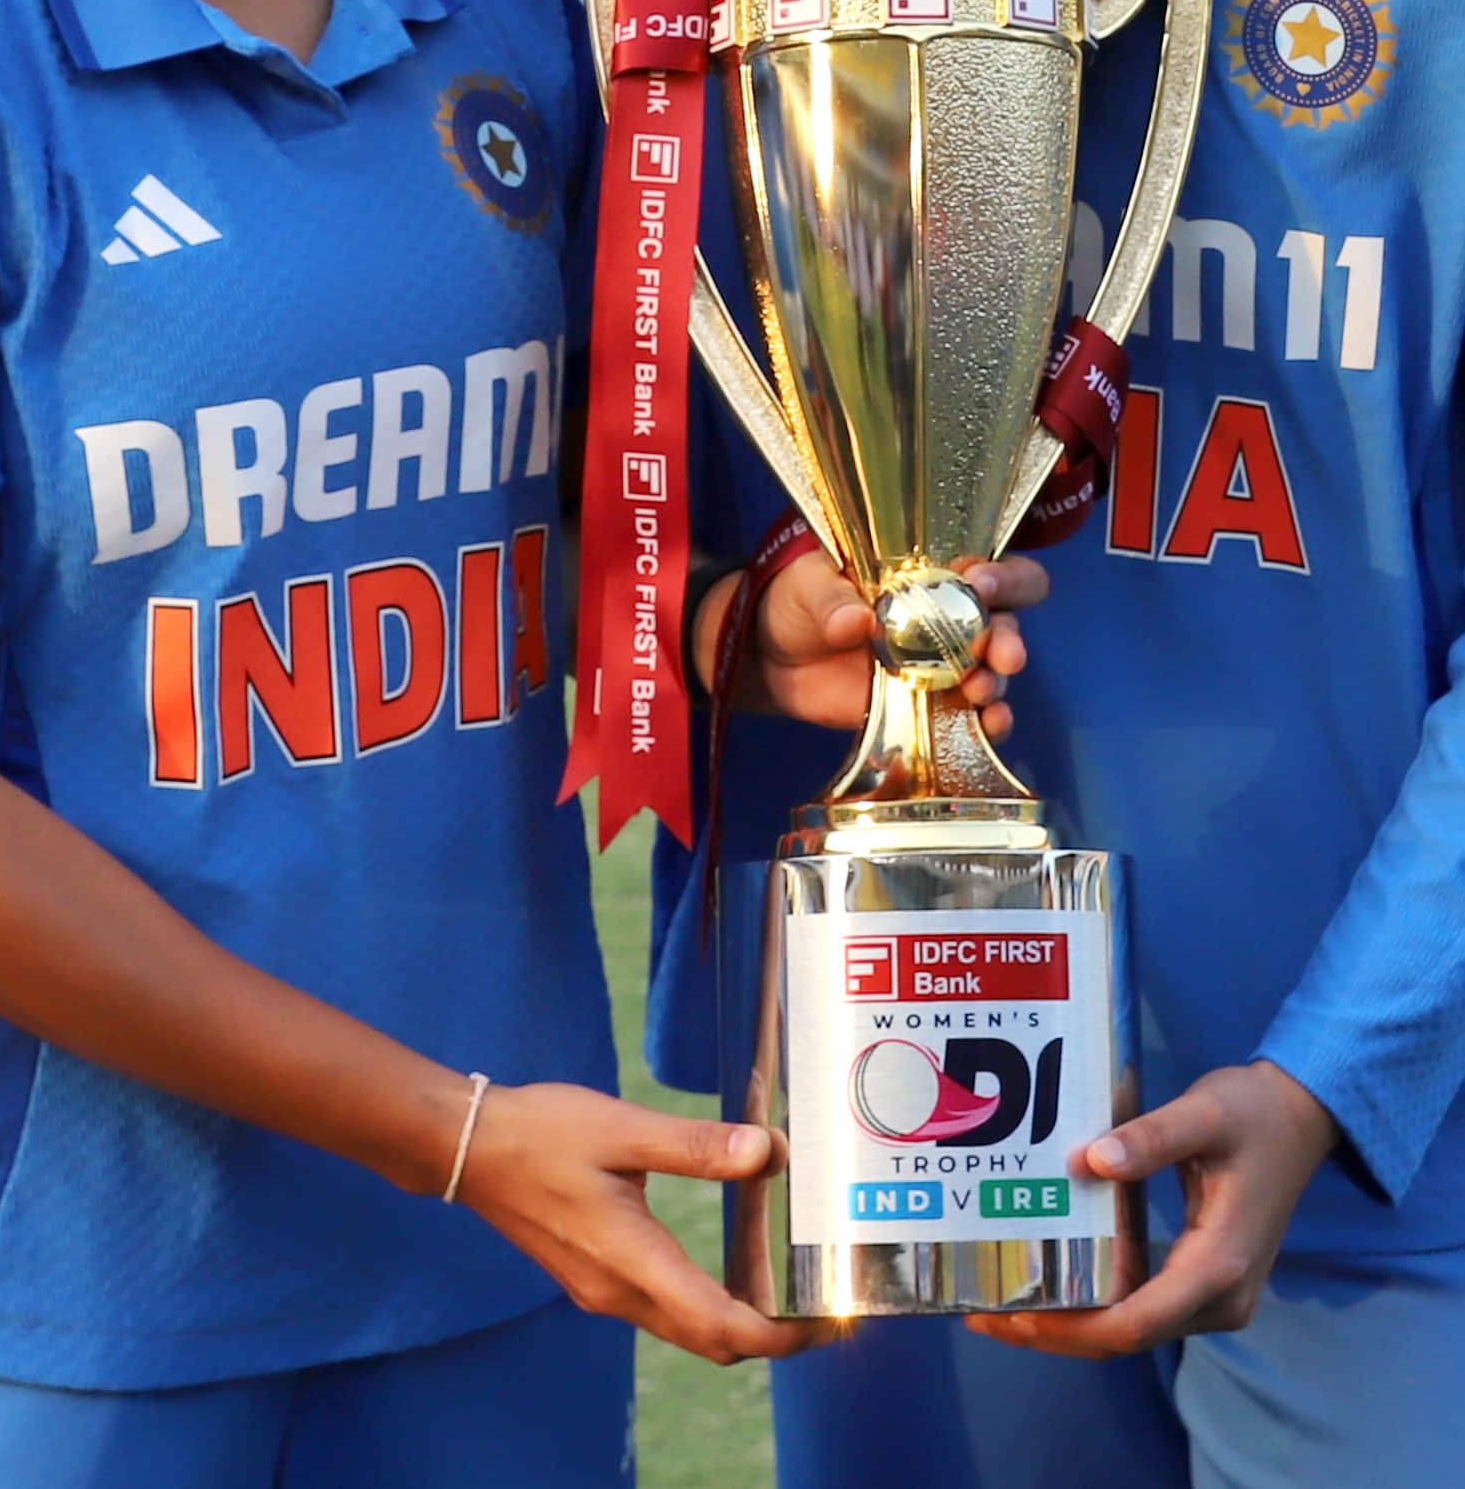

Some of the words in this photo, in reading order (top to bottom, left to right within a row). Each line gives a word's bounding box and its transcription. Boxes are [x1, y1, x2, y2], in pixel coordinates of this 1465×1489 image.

[1256, 44, 1285, 84] BOARD
[1326, 65, 1357, 92] INDIA
[1352, 49, 1364, 63] IN
[638, 189, 665, 259] IDFC
[635, 268, 661, 356] FIRST
[633, 364, 657, 436] Bank
[74, 336, 564, 566] DREAM
[1106, 383, 1311, 575] IA
[635, 508, 659, 575] IDFC
[145, 523, 549, 791] INDIA
[633, 584, 656, 672] FIRST
[631, 679, 655, 753] Bank
[913, 940, 977, 965] IDFC
[984, 939, 1056, 964] FIRST
[914, 972, 982, 996] Bank
[873, 1011, 1040, 1030] WOMEN'S
[890, 1153, 1029, 1175] TROPHY
[856, 1188, 932, 1213] IND
[951, 1189, 973, 1211] V
[992, 1186, 1059, 1211] IRE
